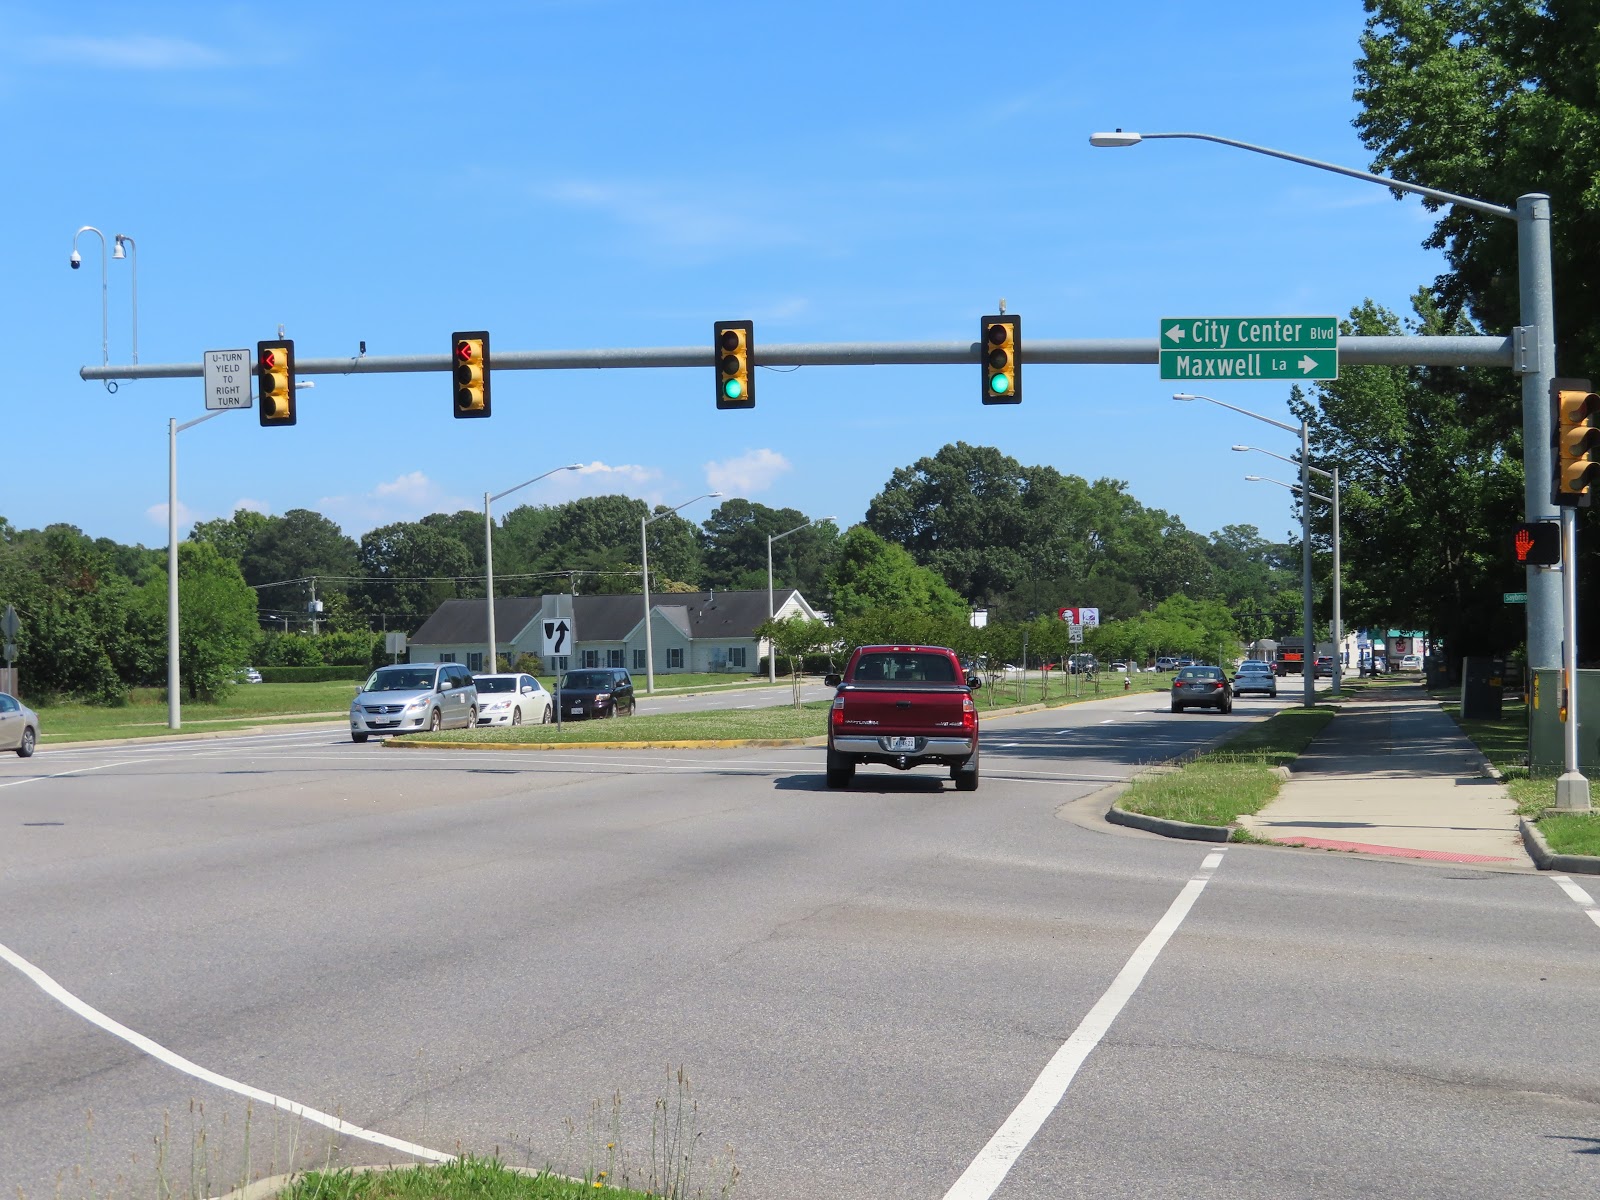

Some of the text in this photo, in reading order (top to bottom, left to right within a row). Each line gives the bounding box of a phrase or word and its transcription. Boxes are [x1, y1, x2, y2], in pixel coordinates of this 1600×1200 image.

[1192, 320, 1334, 348] City Center Blvd
[212, 353, 243, 362] U-TURN
[216, 364, 240, 373] YIELD
[1176, 353, 1287, 376] Maxwell La
[223, 375, 233, 384] TO
[216, 386, 240, 395] RIGHT
[218, 397, 240, 406] TURN
